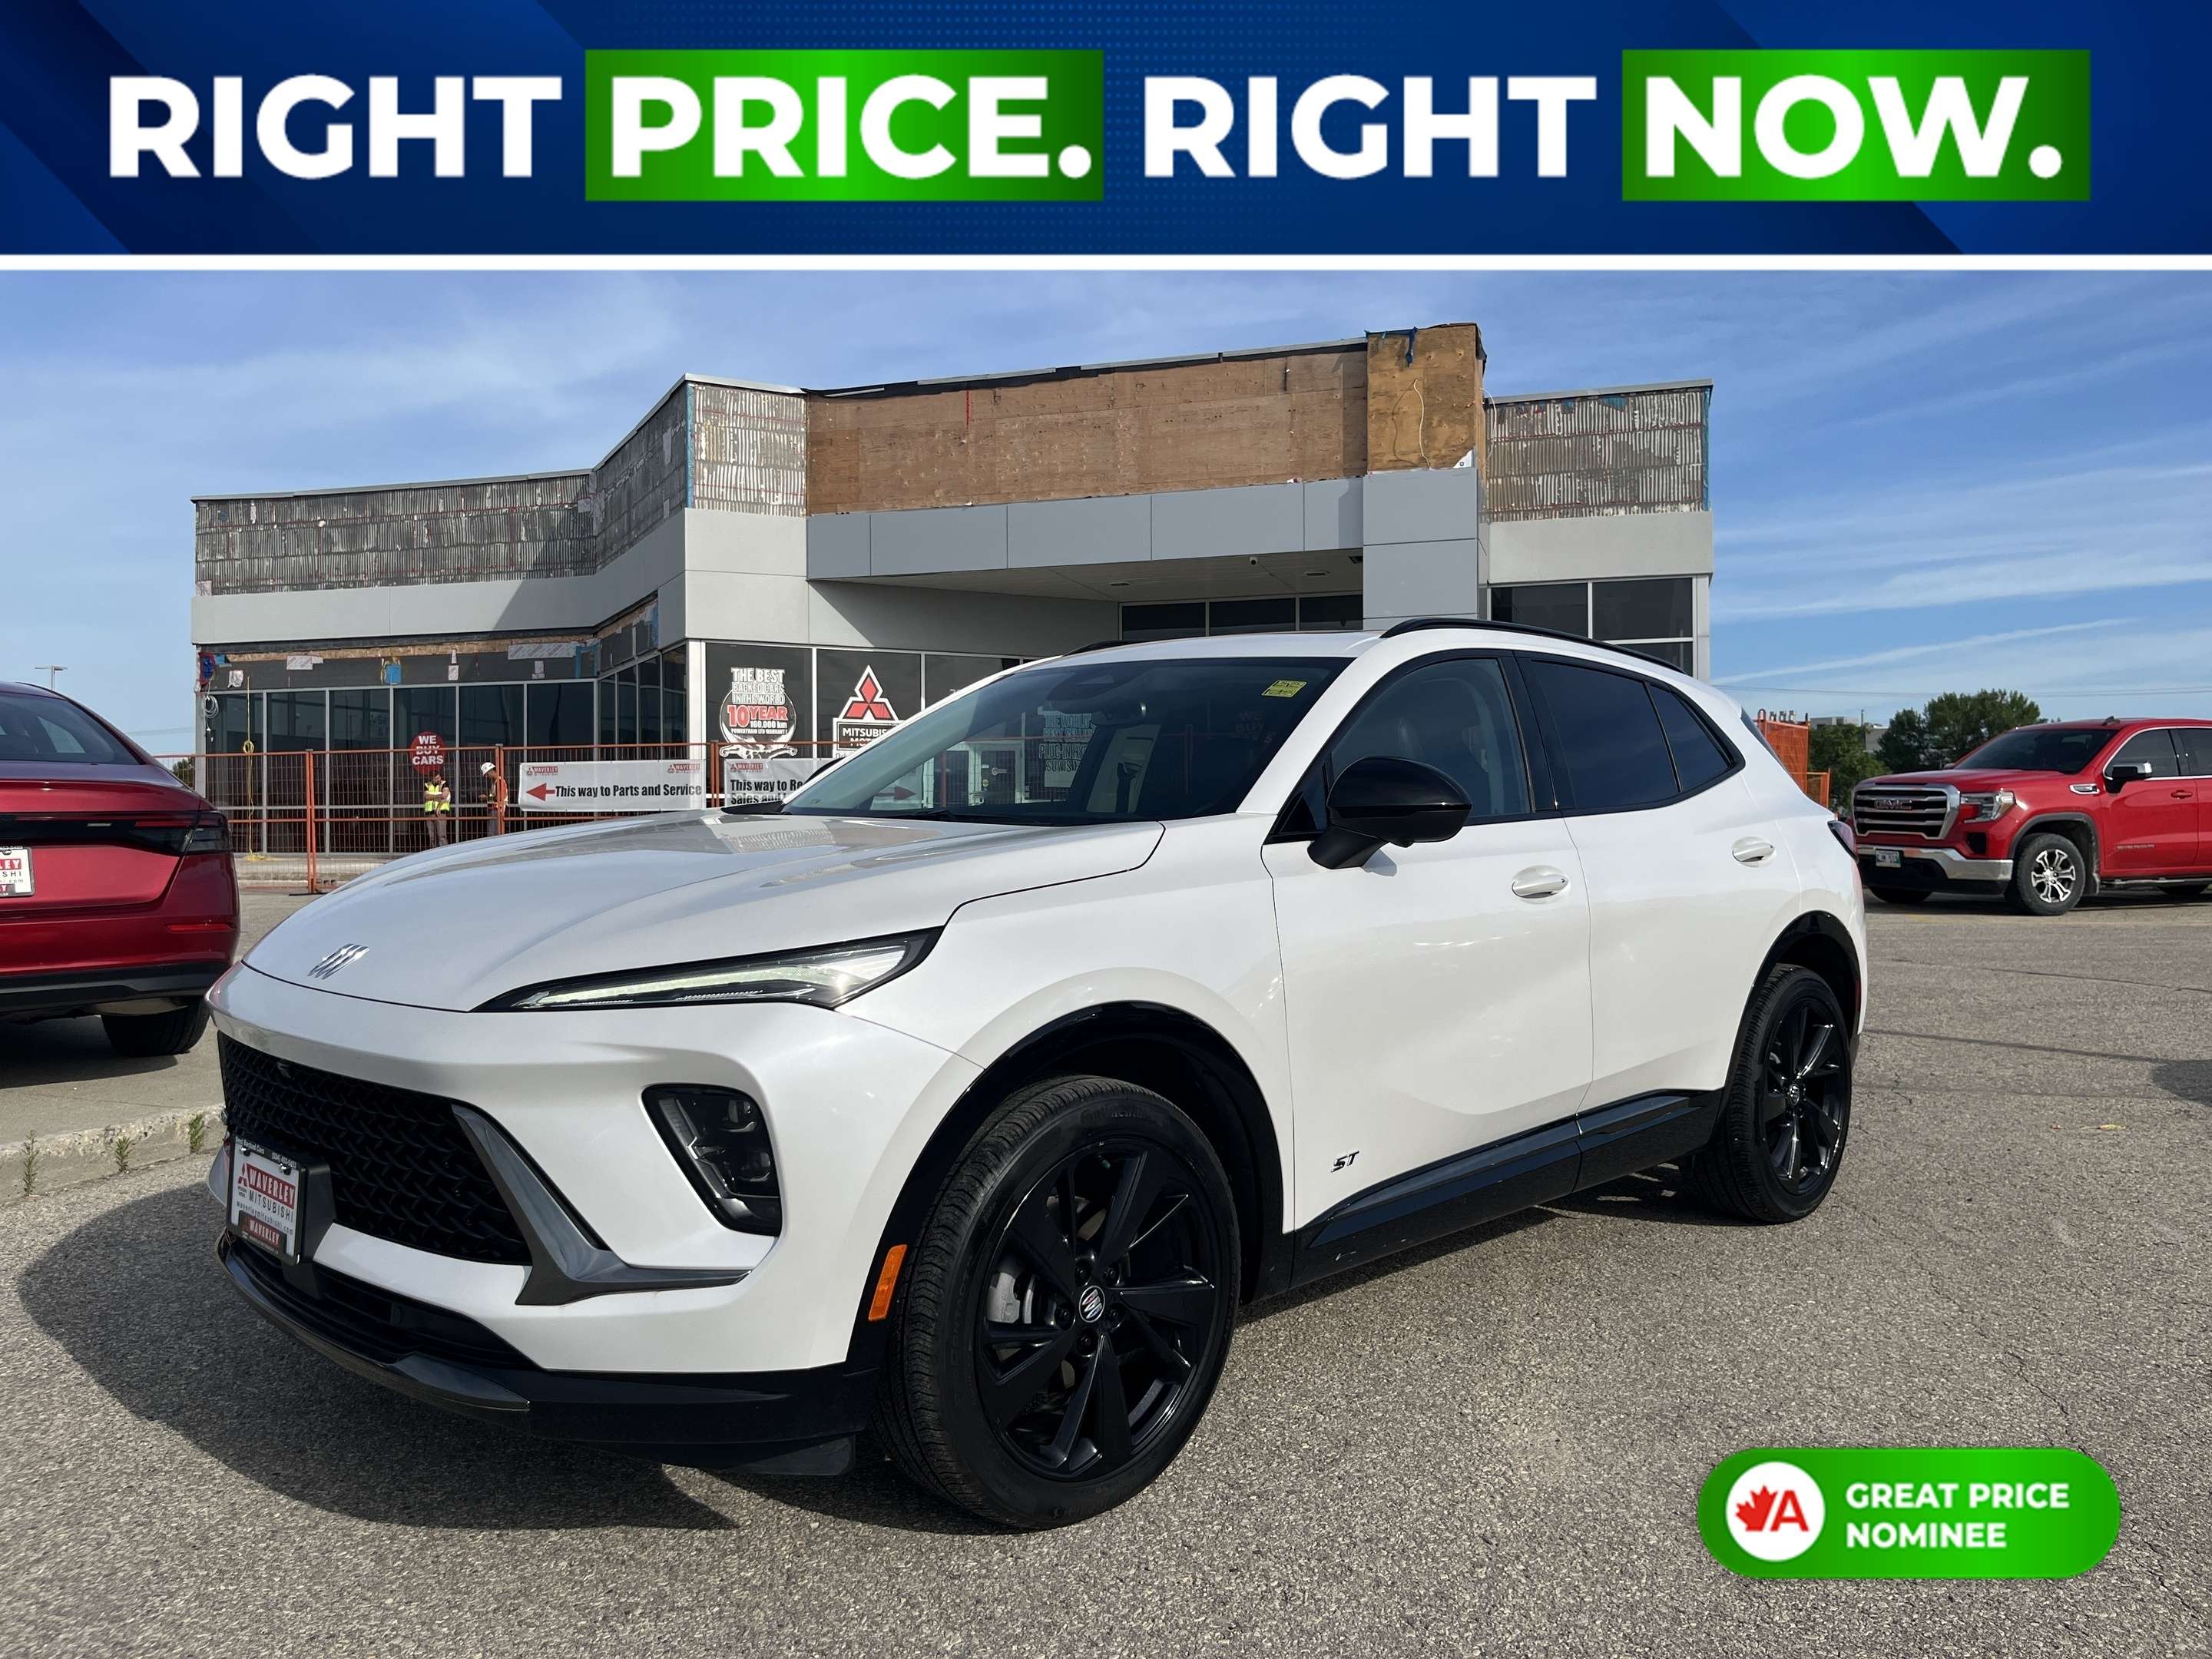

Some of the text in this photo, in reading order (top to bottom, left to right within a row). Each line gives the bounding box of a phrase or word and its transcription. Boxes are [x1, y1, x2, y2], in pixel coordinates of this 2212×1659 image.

[731, 667, 785, 683] THE BEST
[732, 682, 785, 694] BACKED CARS
[757, 694, 785, 704] WORLD
[727, 705, 788, 727] 10 YEAR
[843, 728, 889, 737] MITSUBIS
[418, 735, 437, 744] WE
[416, 745, 440, 755] BUY
[412, 755, 444, 765] CARS
[555, 783, 702, 798] This way to Parts and Service
[730, 780, 807, 792] This way to Re
[1331, 1151, 1360, 1173] ST
[249, 1167, 295, 1206] WAVERLEY
[249, 1190, 294, 1223] MITSUBISHI
[250, 1219, 280, 1245] WAVERLEY
